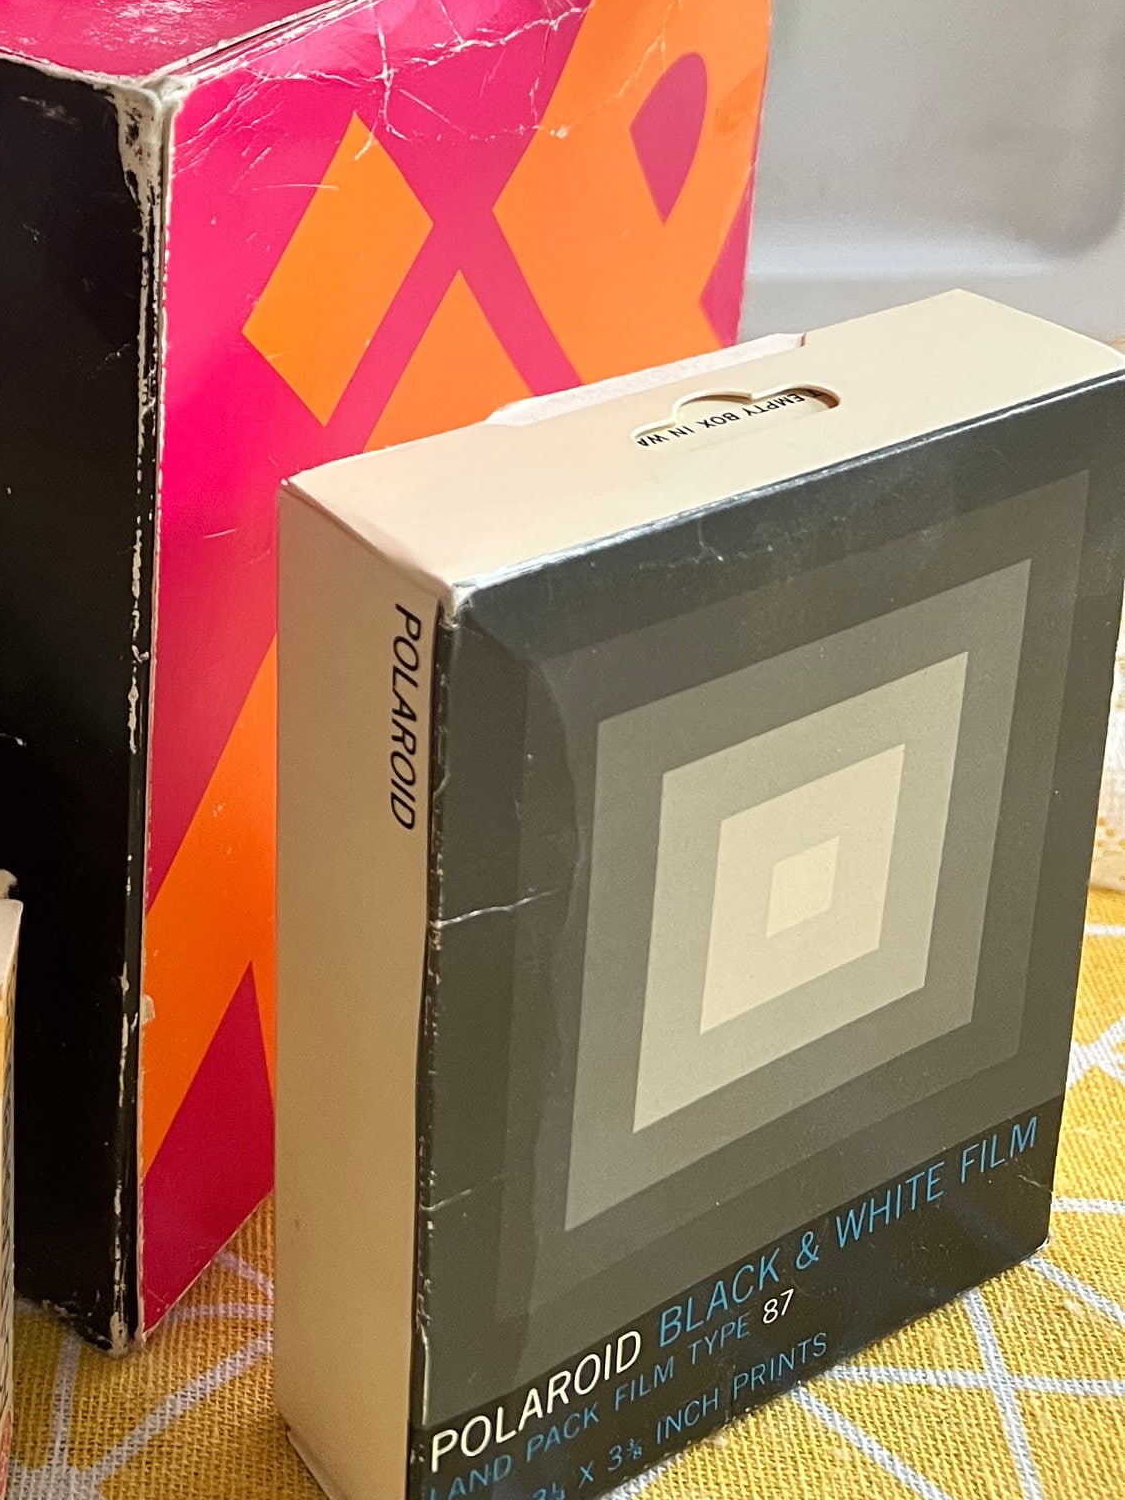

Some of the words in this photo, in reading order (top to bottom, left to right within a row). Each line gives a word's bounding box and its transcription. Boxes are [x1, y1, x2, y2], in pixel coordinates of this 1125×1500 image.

[668, 425, 695, 437] IN
[697, 411, 740, 429] BOX
[742, 393, 806, 417] EMPTY
[389, 603, 422, 831] POLAROID
[431, 1330, 642, 1473] POLAROID
[658, 1247, 781, 1348] BLACK
[795, 1230, 820, 1271] &
[835, 1161, 946, 1248] WHITE
[961, 1115, 1038, 1184] FILM
[526, 1402, 599, 1462] PACK
[614, 1356, 675, 1411] FILM
[687, 1312, 751, 1365] TYPE
[761, 1287, 795, 1325] 87
[655, 1387, 719, 1444] INCH
[732, 1332, 828, 1401] PRINTS
